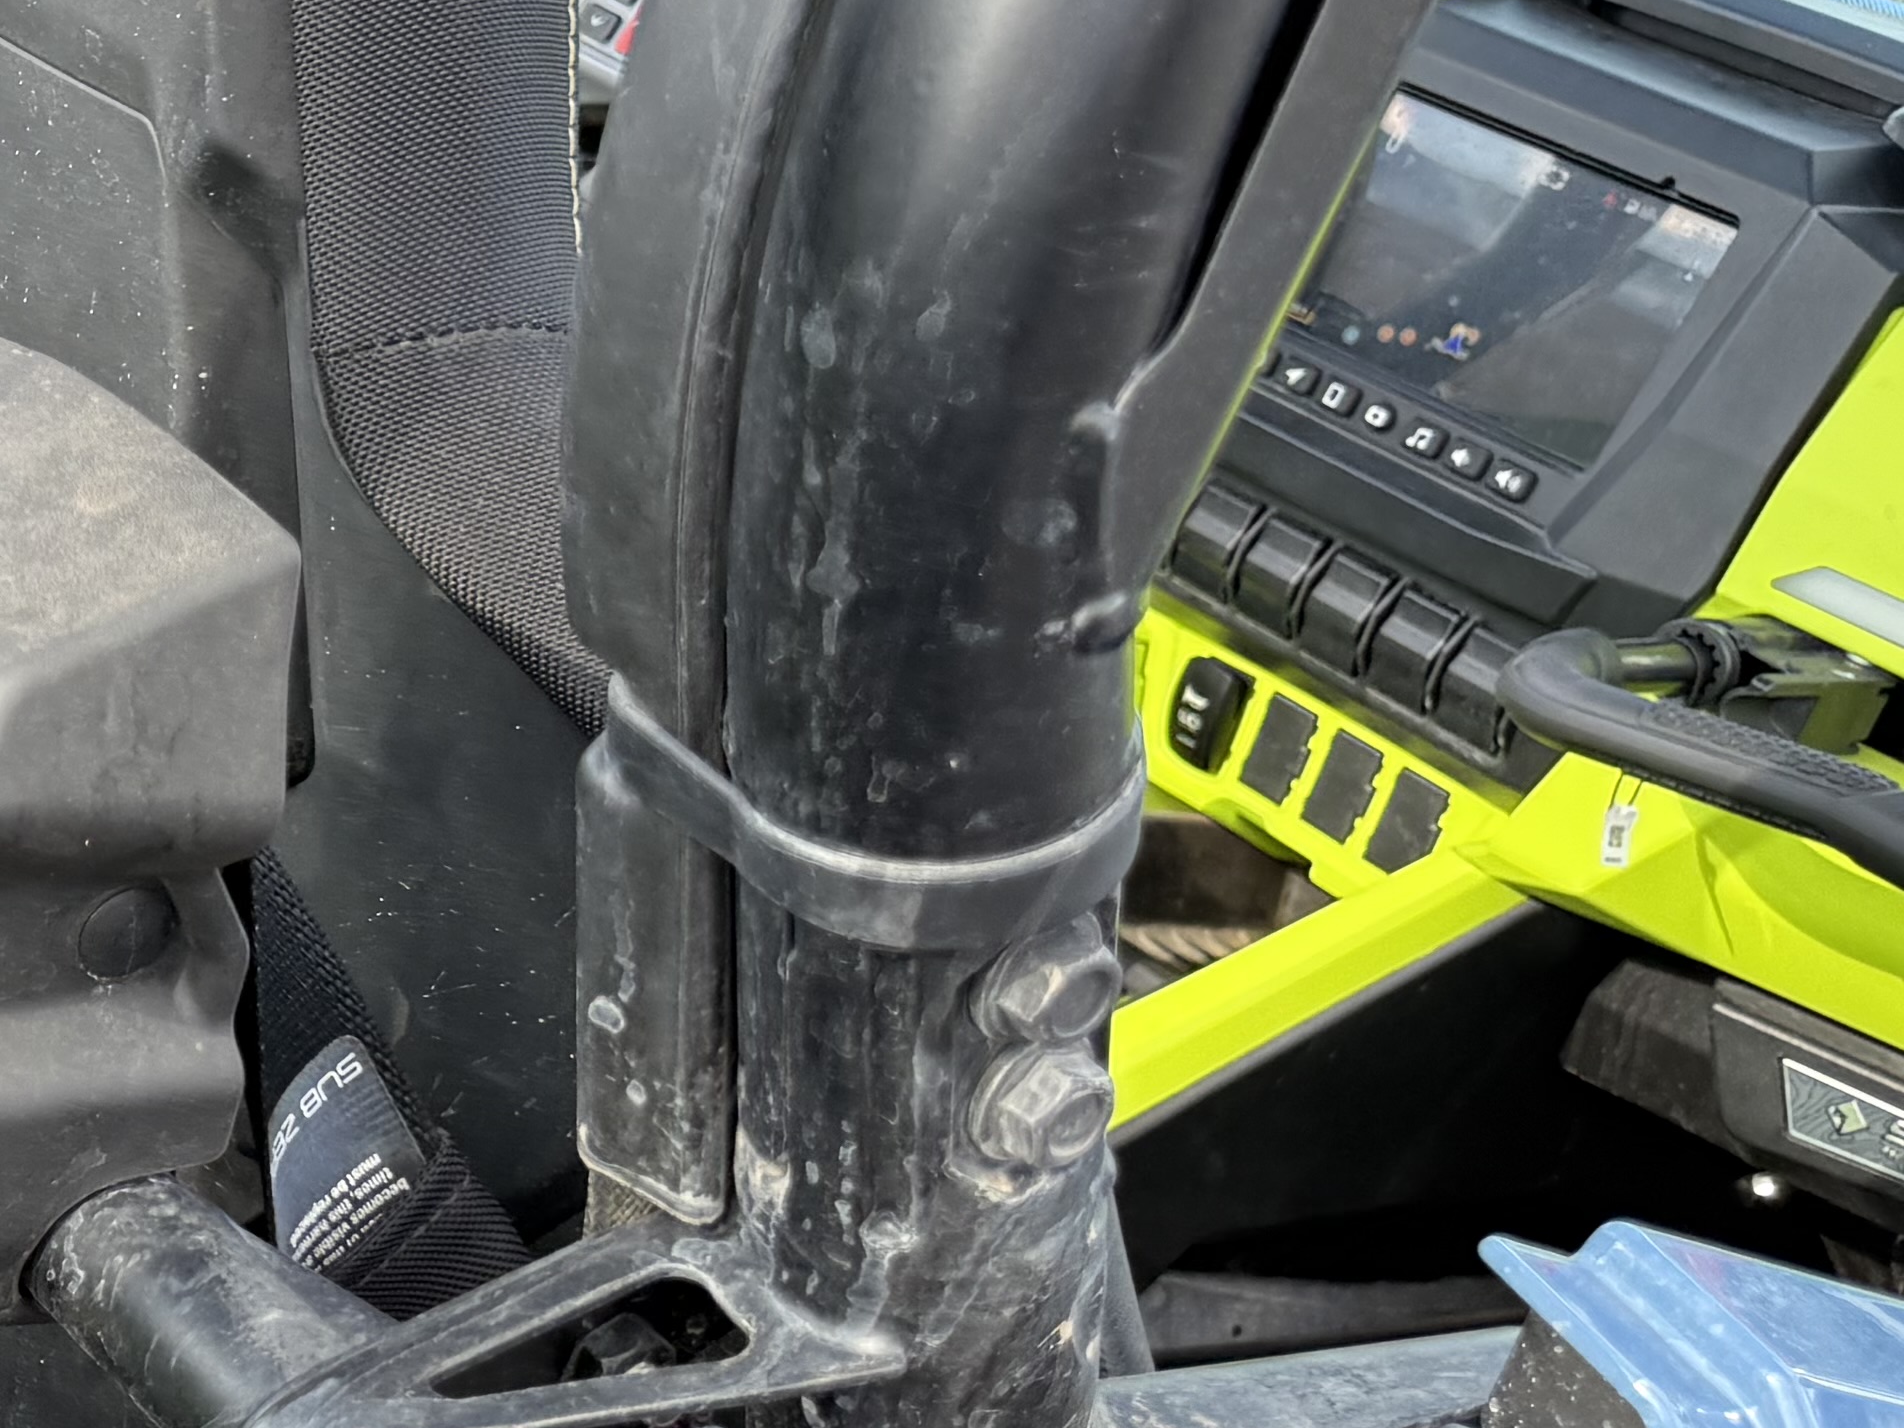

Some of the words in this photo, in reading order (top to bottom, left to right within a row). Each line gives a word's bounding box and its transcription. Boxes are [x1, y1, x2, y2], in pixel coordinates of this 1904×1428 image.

[299, 1052, 363, 1119] SUB
[345, 1153, 382, 1187] must
[350, 1167, 393, 1200] times,
[330, 1179, 349, 1199] be
[350, 1177, 410, 1225] becomes
[328, 1198, 353, 1223] this
[313, 1222, 351, 1258] visible
